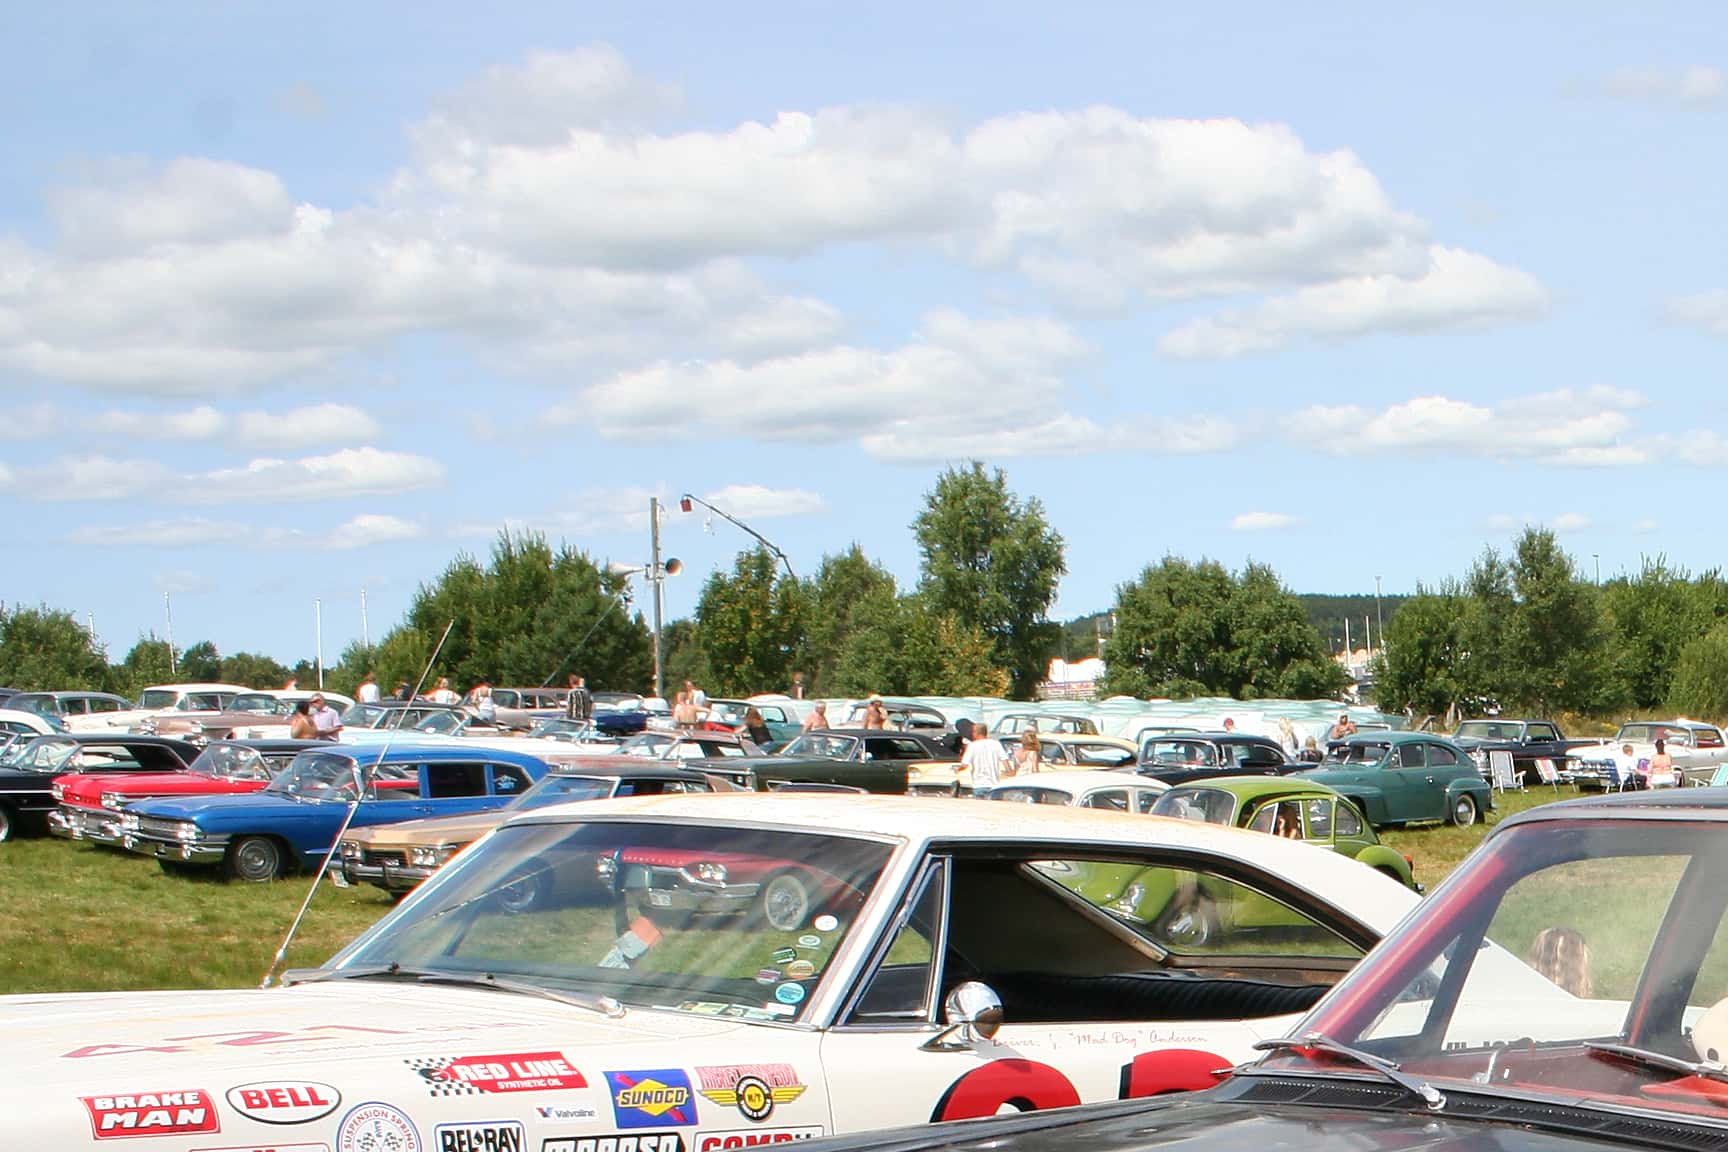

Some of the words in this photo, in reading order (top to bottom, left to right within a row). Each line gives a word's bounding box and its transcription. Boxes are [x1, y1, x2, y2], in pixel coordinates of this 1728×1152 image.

[452, 1062, 510, 1081] RED
[510, 1059, 573, 1078] LINE
[497, 1079, 546, 1090] SYNTHETIC
[547, 1078, 564, 1087] OIL
[94, 1091, 201, 1111] BRAKE
[239, 1086, 330, 1110] BELL
[620, 1088, 686, 1106] SUNOCO
[101, 1108, 206, 1130] MAN
[554, 1108, 596, 1119] Valvoline
[343, 1109, 389, 1150] SUSPENSION
